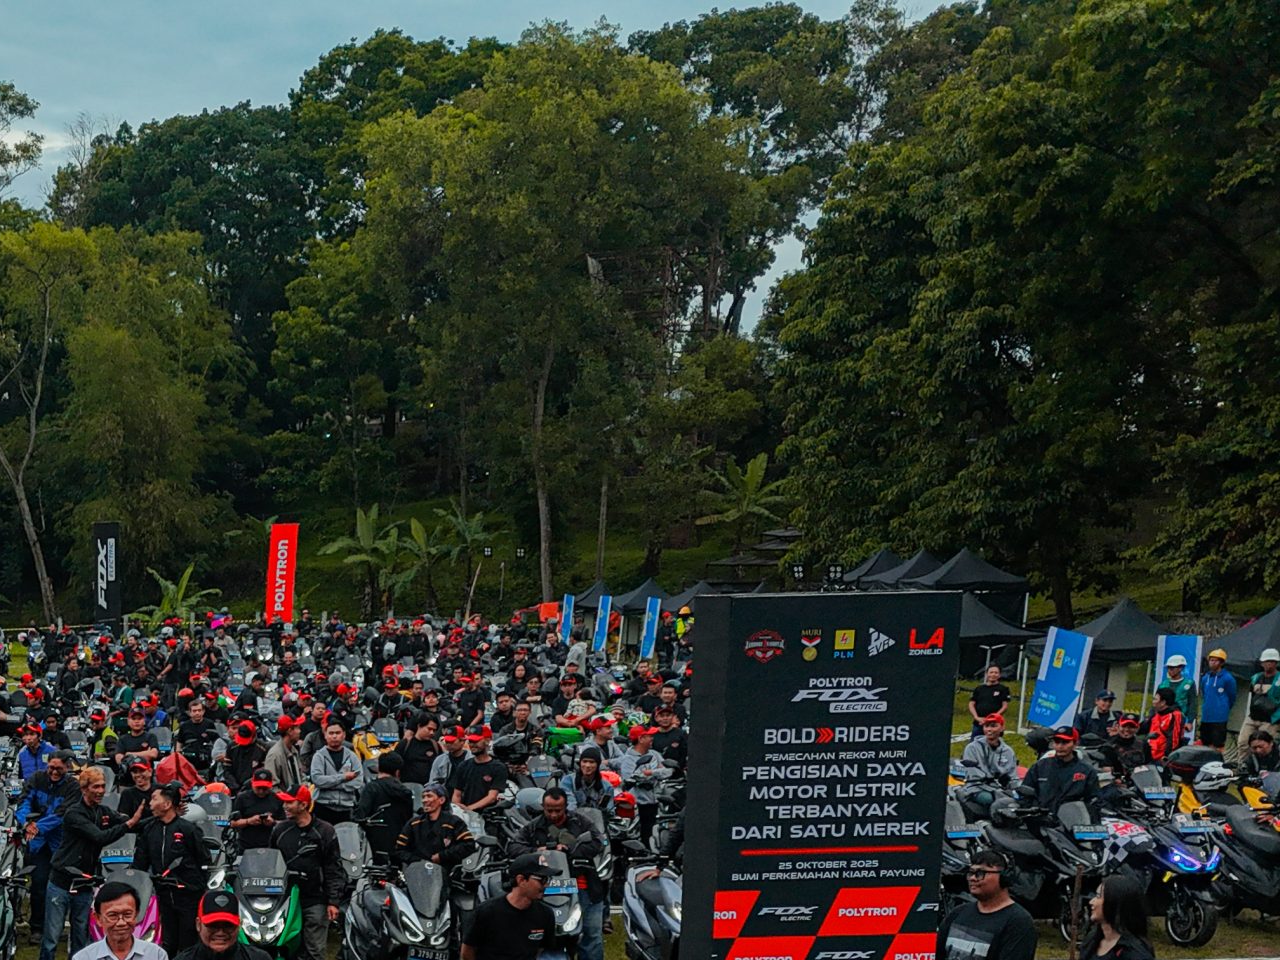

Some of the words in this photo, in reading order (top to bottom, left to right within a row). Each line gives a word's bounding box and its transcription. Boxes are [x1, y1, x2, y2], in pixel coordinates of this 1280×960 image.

[274, 539, 289, 611] POLYTRON
[909, 627, 945, 649] LA
[809, 676, 872, 688] POLYTRON
[791, 687, 888, 702] FOX
[833, 703, 883, 711] ELECTRIC
[764, 728, 816, 744] BOLD
[834, 725, 910, 743] RIDERS
[765, 752, 835, 761] PEMECAHAN
[839, 751, 875, 760] REKOR
[879, 750, 907, 758] MURI
[742, 764, 858, 780] PENGISIAN
[867, 762, 926, 777] DAYA
[749, 784, 828, 800] MOTOR
[836, 782, 916, 798] LISTRIK
[766, 803, 898, 819] TERBANYAK
[731, 825, 782, 840] DARI
[790, 823, 846, 838] SATU
[853, 821, 930, 837] MEREK
[778, 862, 793, 870] 25
[796, 861, 847, 869] OKTOBER
[850, 860, 879, 868] 2025
[731, 872, 759, 881] BUMI
[762, 870, 840, 880] PERKEMAHAN
[843, 869, 877, 878] KIARA
[880, 868, 925, 877] PAYUNG
[838, 907, 897, 918] POLYTRON
